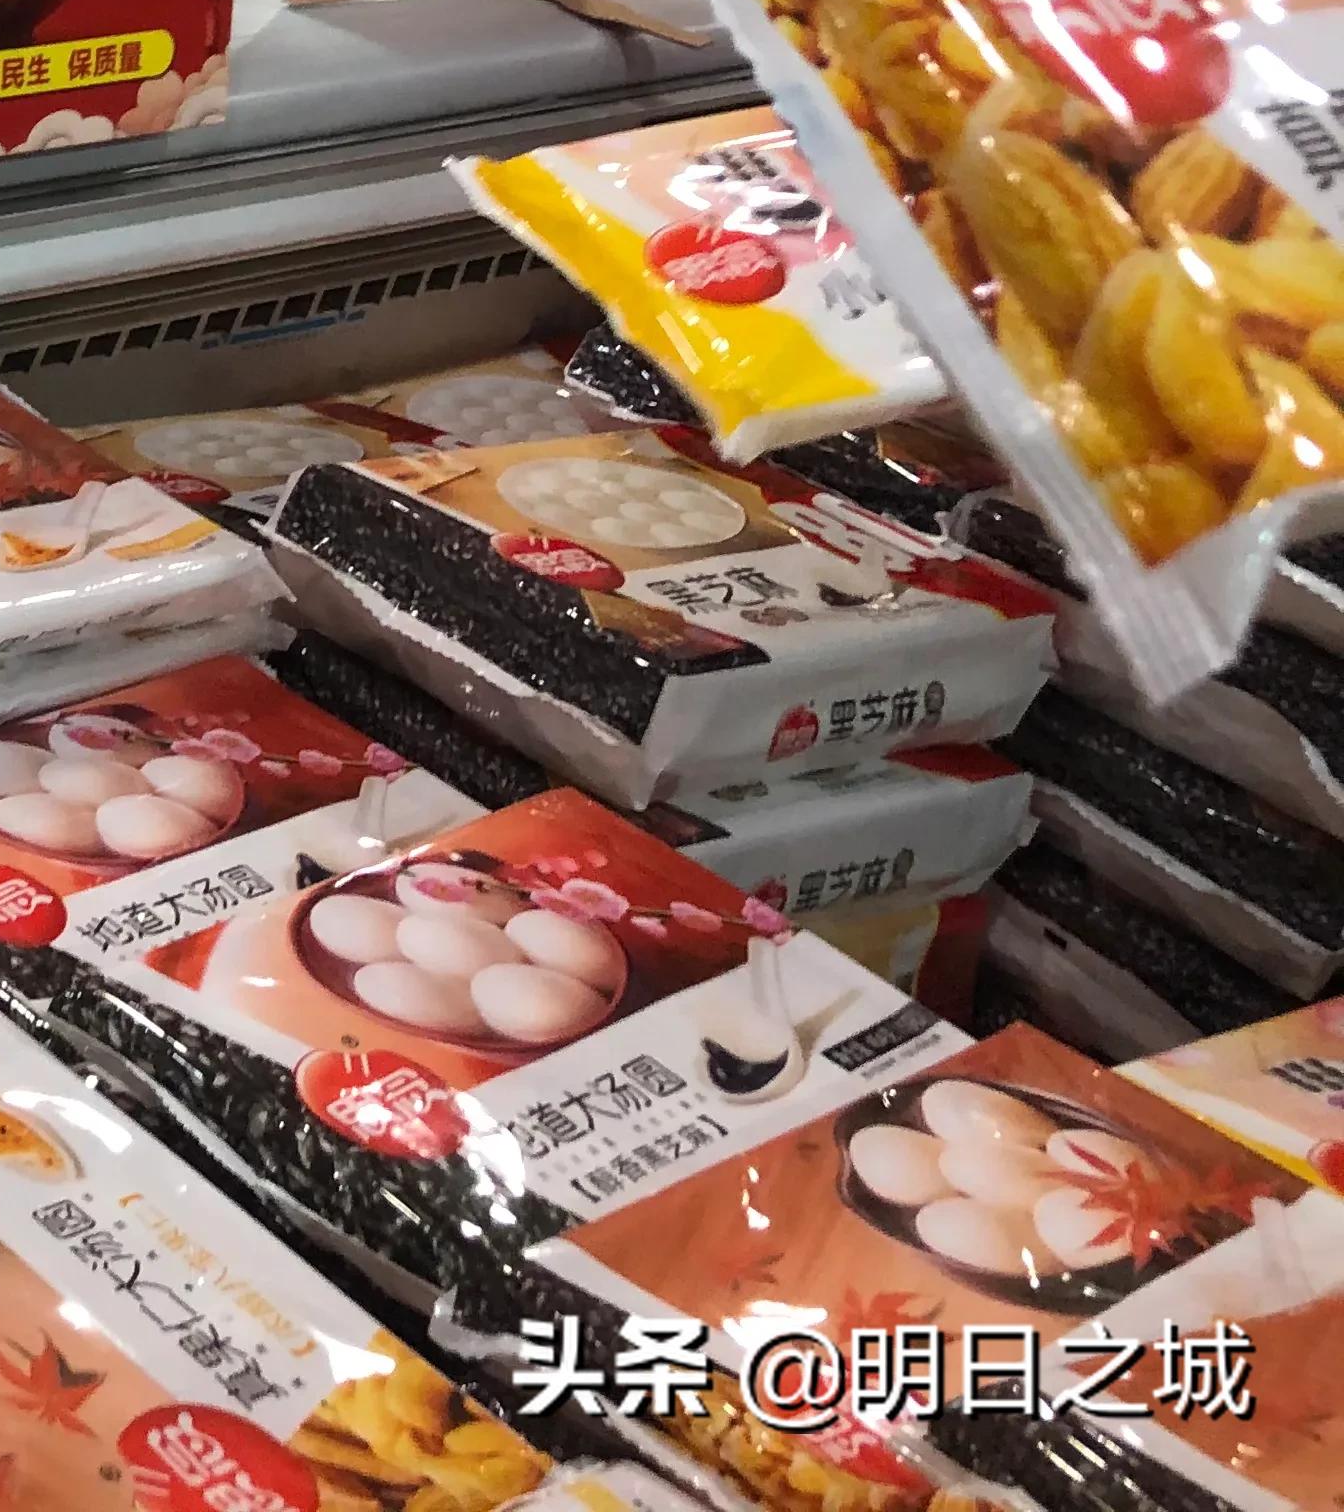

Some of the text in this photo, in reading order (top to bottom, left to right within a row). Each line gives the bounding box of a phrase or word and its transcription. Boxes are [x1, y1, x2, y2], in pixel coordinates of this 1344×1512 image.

[67, 41, 145, 81] 保质量
[75, 863, 276, 954] 地道大汤圆
